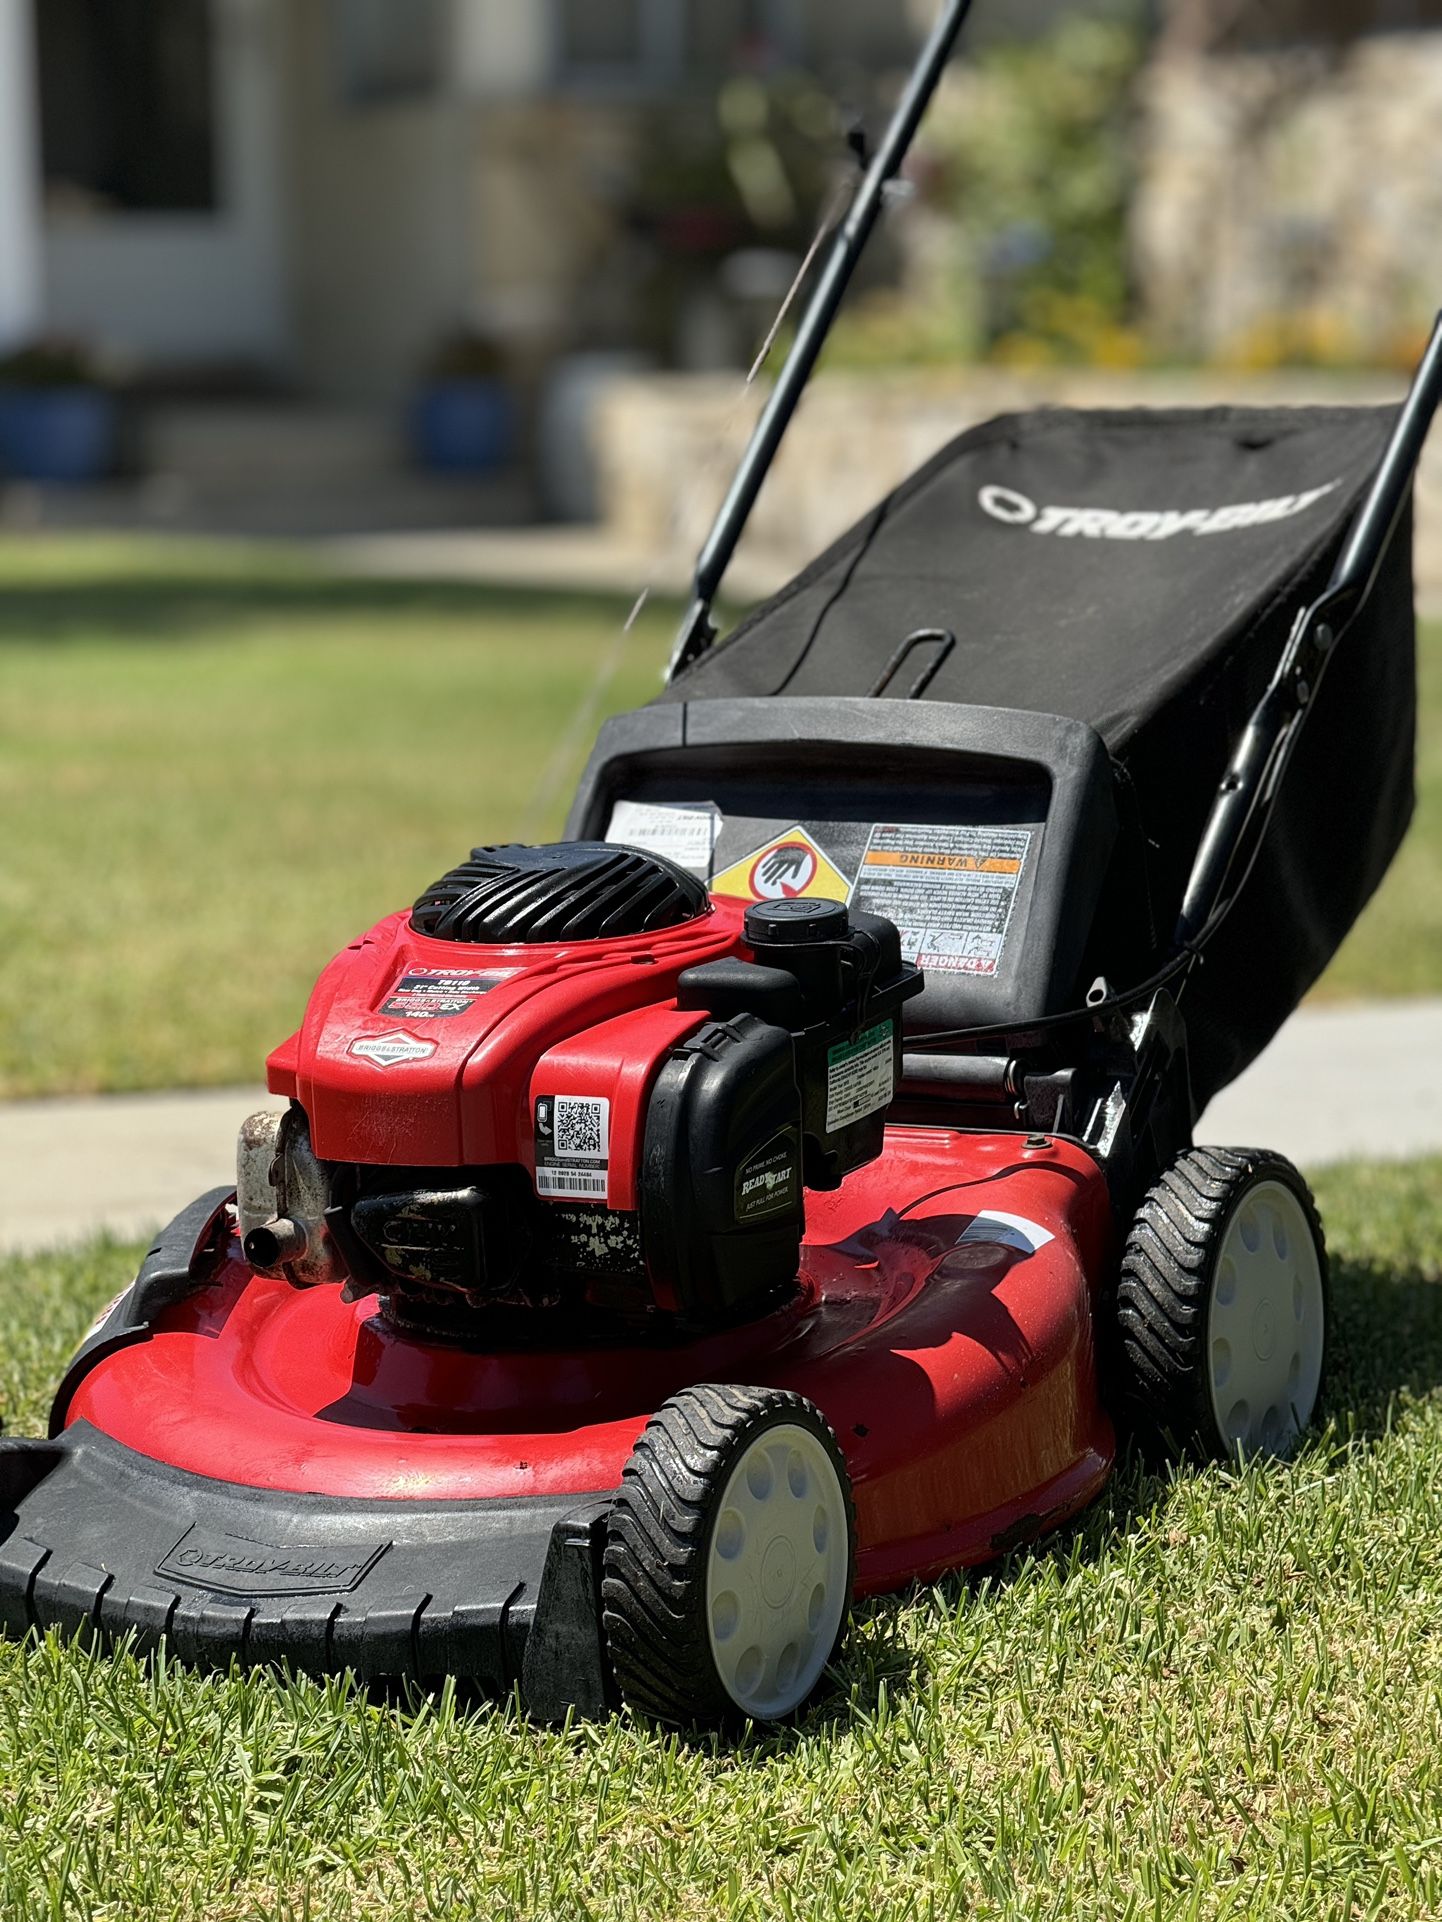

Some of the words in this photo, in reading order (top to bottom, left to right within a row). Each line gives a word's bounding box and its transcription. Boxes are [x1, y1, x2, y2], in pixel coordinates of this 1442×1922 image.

[1032, 477, 1343, 540] TROY-BILT
[899, 854, 967, 867] WARNING
[920, 955, 978, 967] DANGER
[199, 1552, 358, 1578] TROY-BILT
